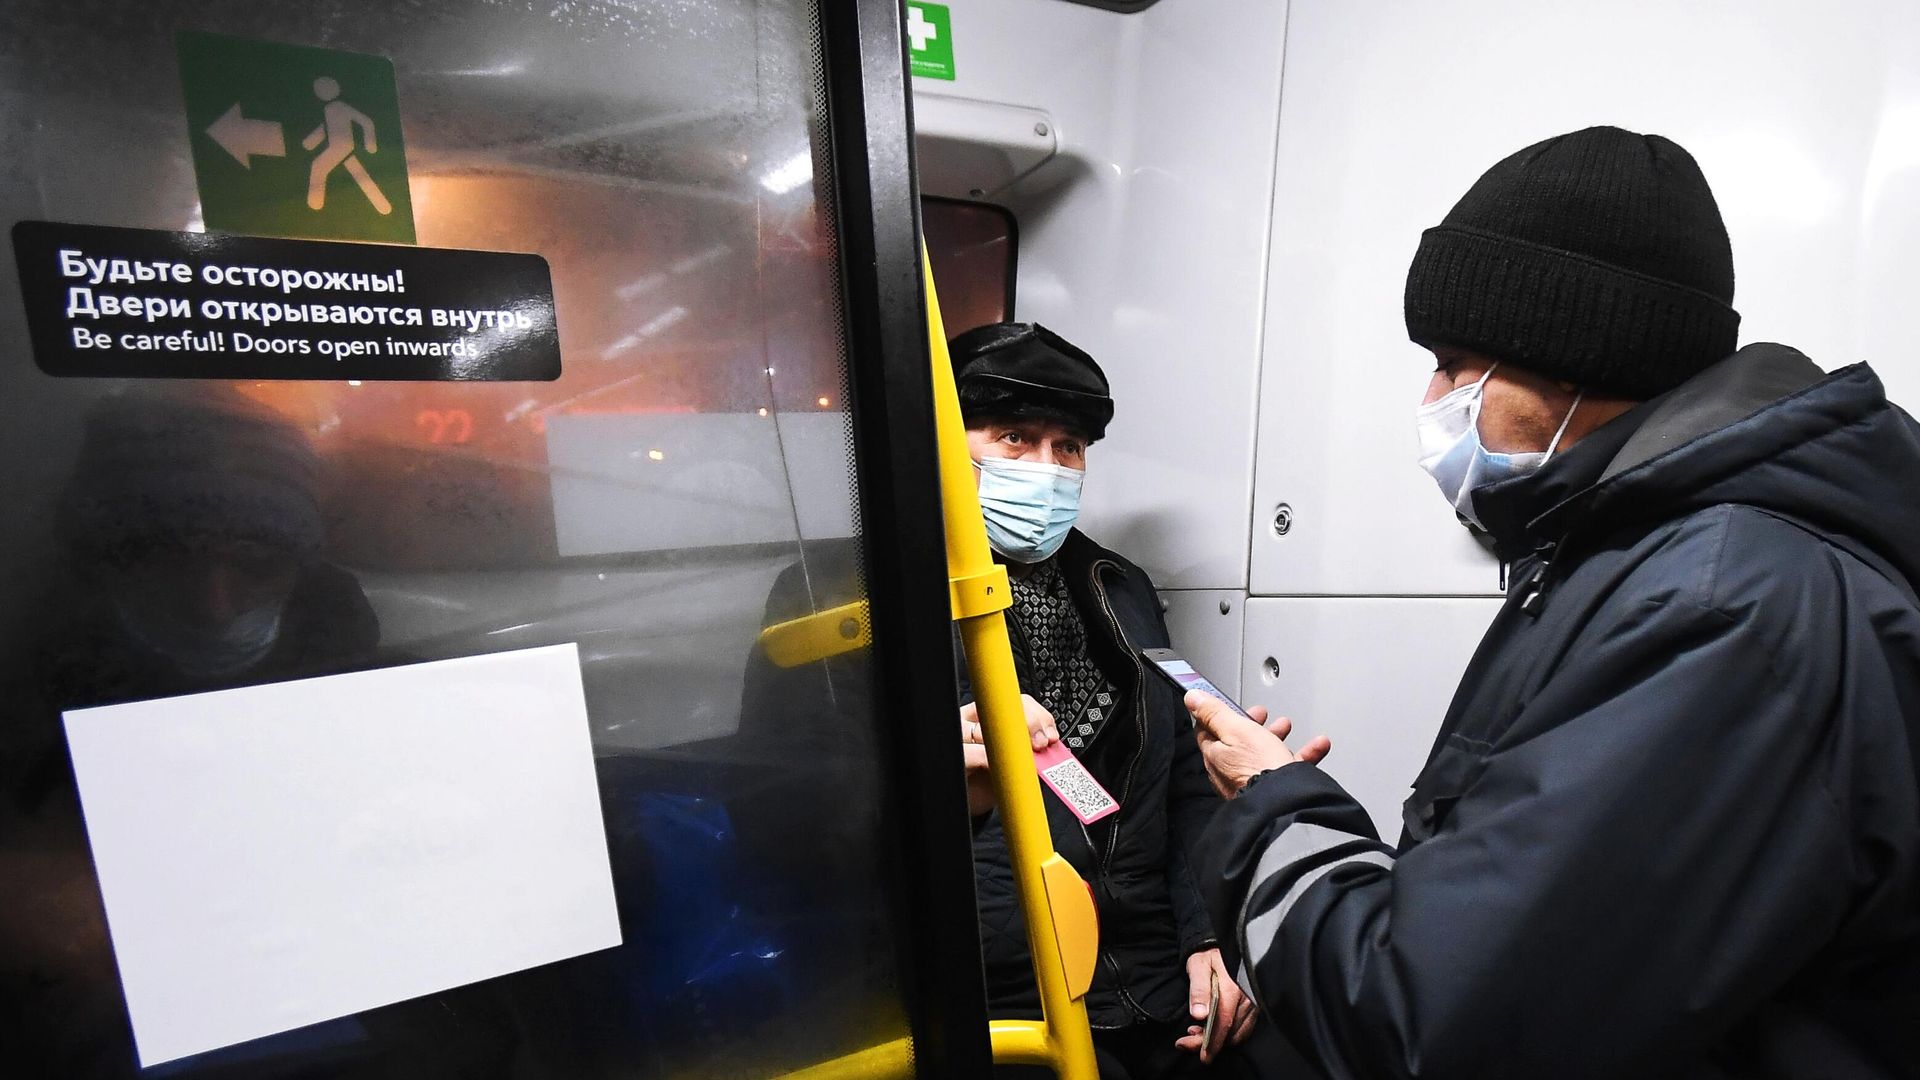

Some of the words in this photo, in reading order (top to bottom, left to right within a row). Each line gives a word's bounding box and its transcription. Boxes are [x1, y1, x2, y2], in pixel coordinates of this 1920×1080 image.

[60, 249, 193, 285] Будьте
[202, 264, 405, 294] осторожны!
[66, 286, 192, 323] Двери
[201, 299, 423, 327] открываются
[431, 308, 533, 333] внутрь
[72, 327, 112, 349] Be
[120, 329, 225, 352] careful!
[233, 331, 312, 354] Doors
[318, 338, 381, 361] open
[386, 336, 478, 357] inwards
